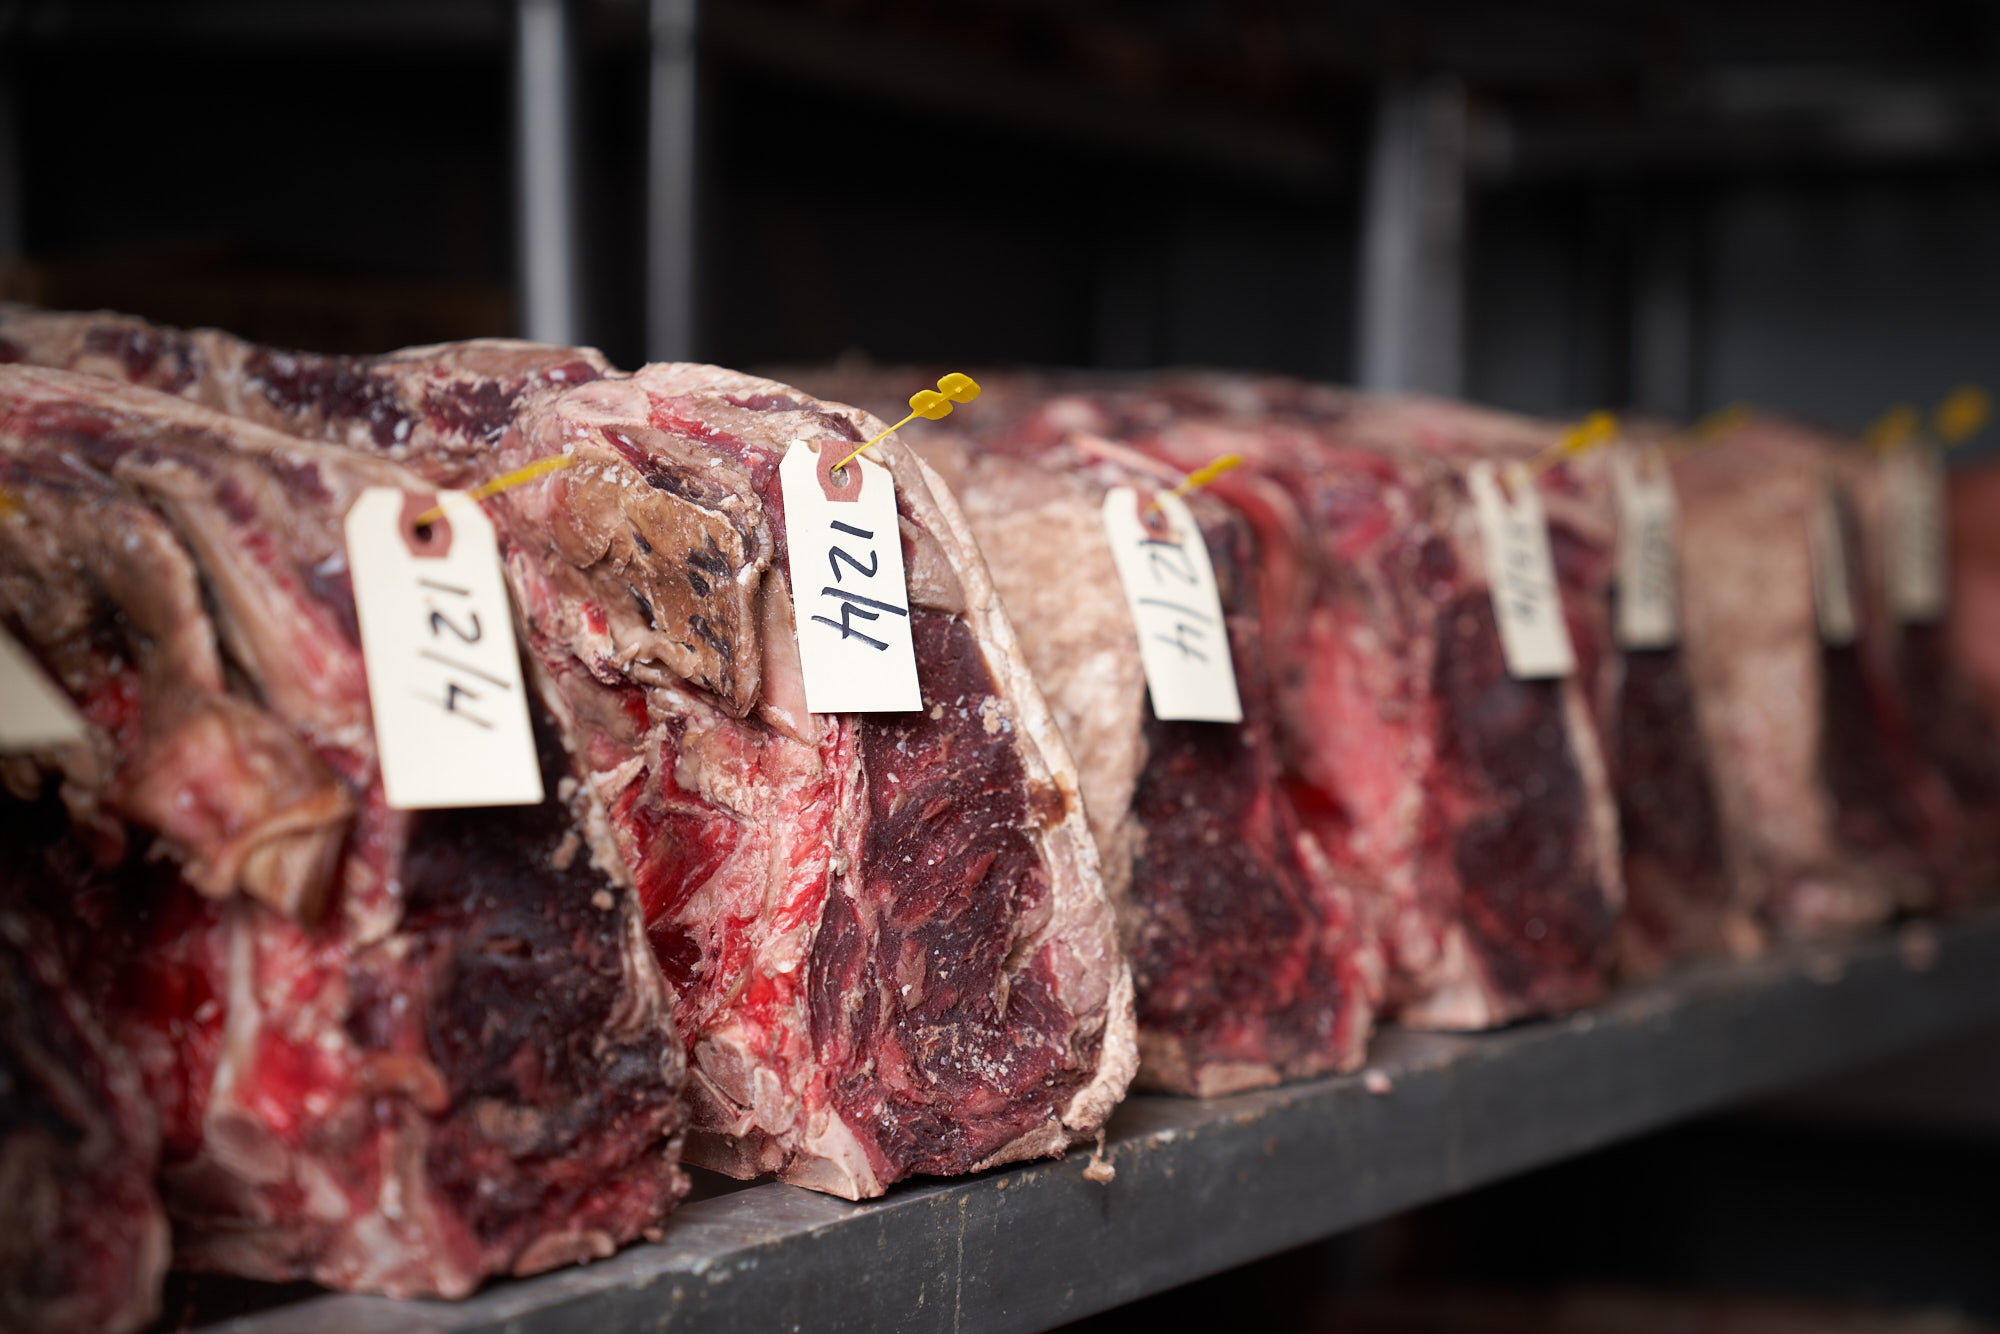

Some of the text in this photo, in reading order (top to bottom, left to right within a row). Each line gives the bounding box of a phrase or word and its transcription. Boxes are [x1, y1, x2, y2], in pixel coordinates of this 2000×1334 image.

[811, 520, 908, 652] 12/4
[1137, 538, 1213, 664] 12/4
[411, 577, 510, 731] 12/4
